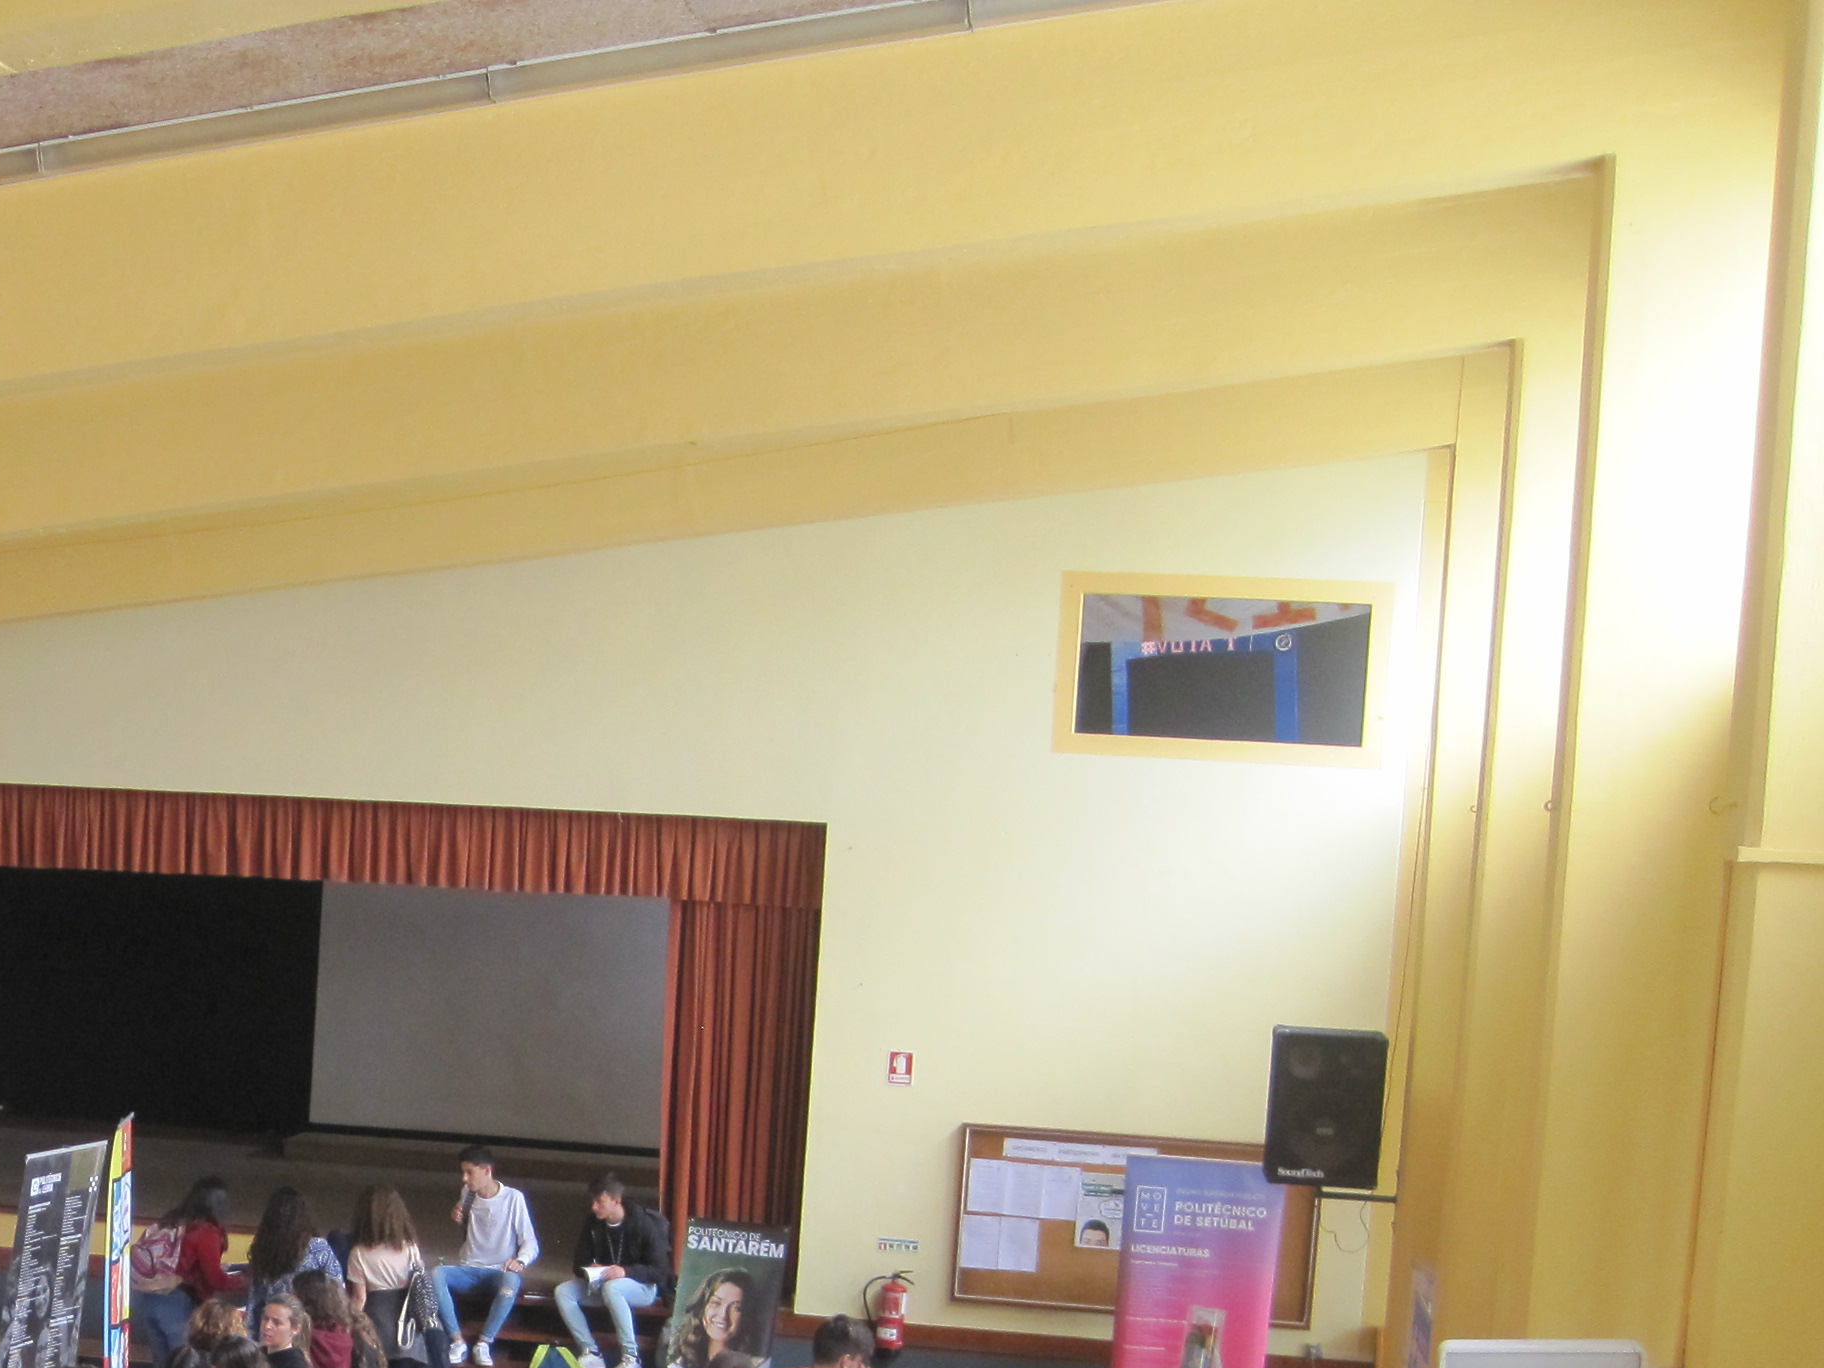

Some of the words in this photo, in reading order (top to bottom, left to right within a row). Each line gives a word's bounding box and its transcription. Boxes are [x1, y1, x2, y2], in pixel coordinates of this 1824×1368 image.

[1175, 1201, 1267, 1218] POLITÉCNICO
[1174, 1214, 1191, 1226] DE
[687, 1236, 784, 1258] SANTARÉM
[1131, 1244, 1210, 1258] LICENCIATURAS
